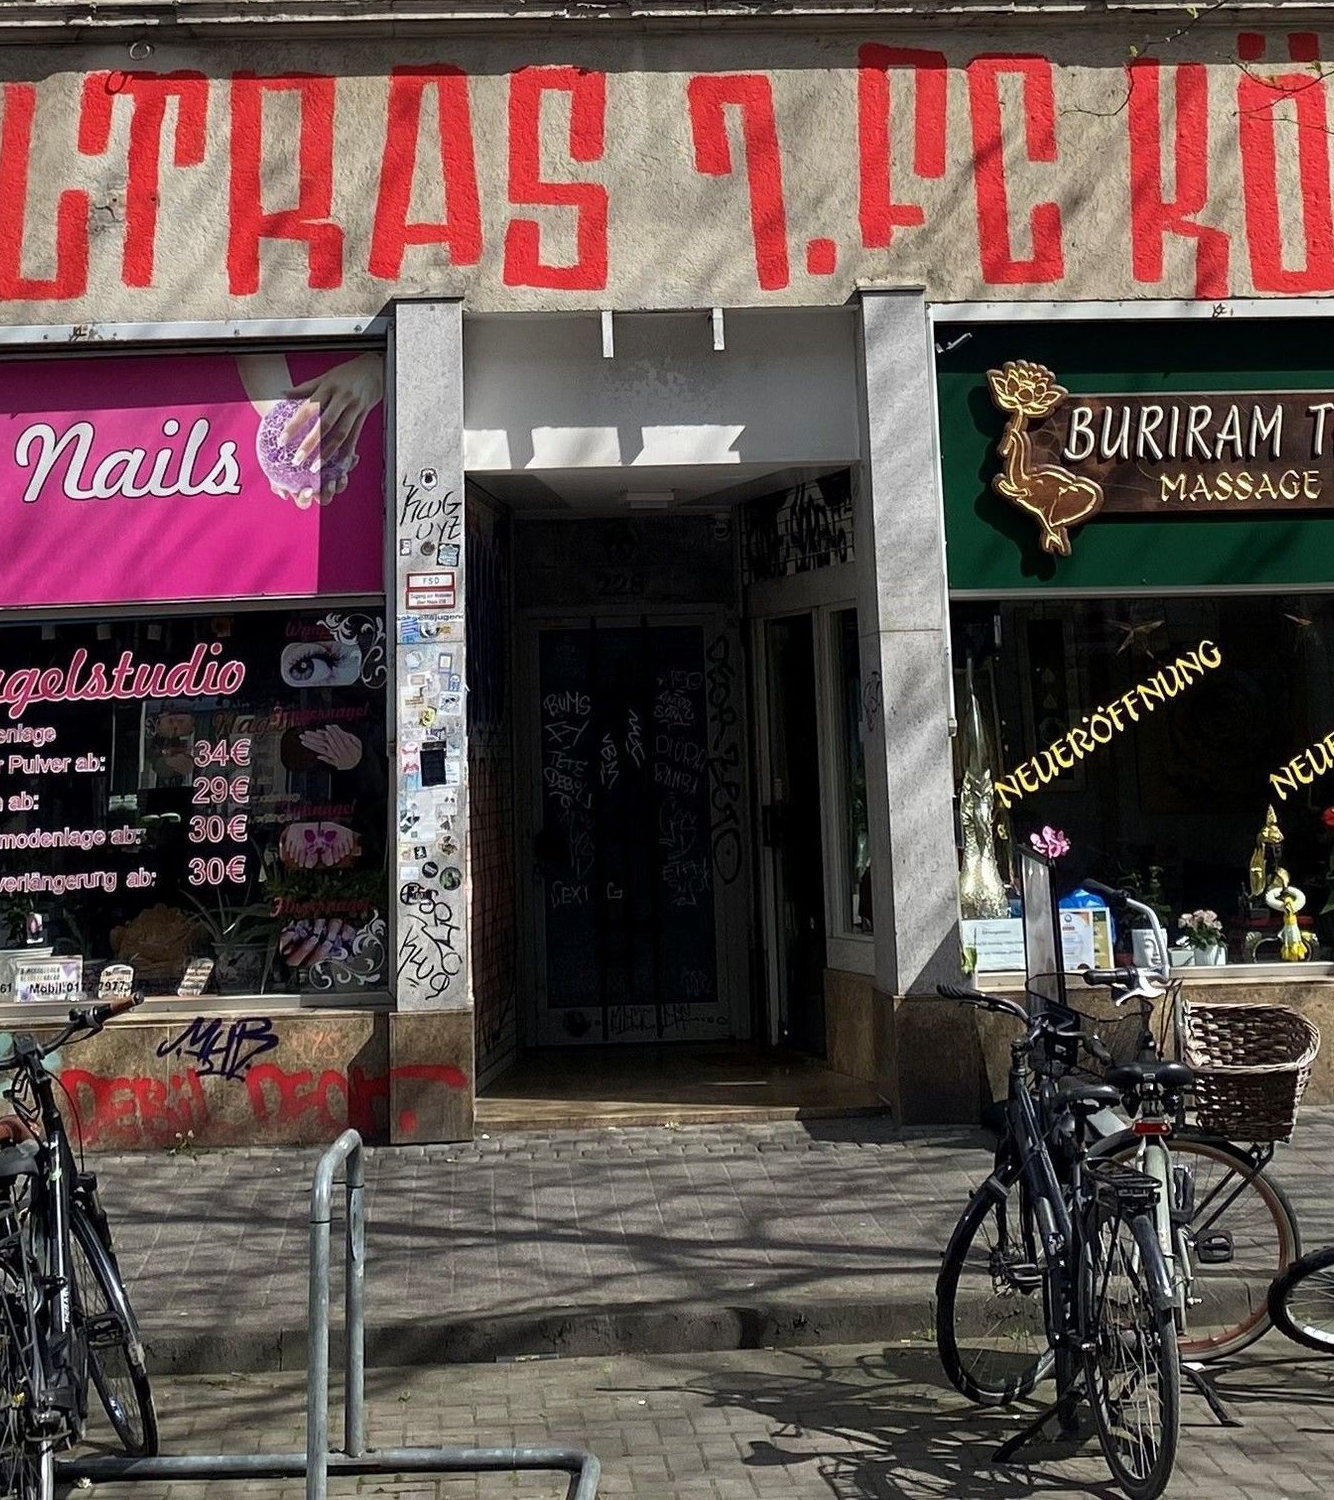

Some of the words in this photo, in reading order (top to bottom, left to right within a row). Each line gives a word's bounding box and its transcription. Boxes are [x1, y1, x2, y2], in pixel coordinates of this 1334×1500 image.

[1064, 402, 1285, 462] BURIRAM
[13, 417, 242, 505] Nails
[1159, 469, 1322, 503] MASSAGE
[995, 639, 1224, 810] NEUERÖFFNUNG
[8, 753, 72, 775] Pulver
[74, 752, 106, 772] ab:
[193, 738, 252, 768] 34€
[7, 791, 40, 812] ab:
[191, 775, 251, 805] 29€
[110, 825, 143, 845] ab:
[188, 814, 248, 844] 30€
[126, 867, 157, 888] ab:
[188, 854, 247, 886] 30€
